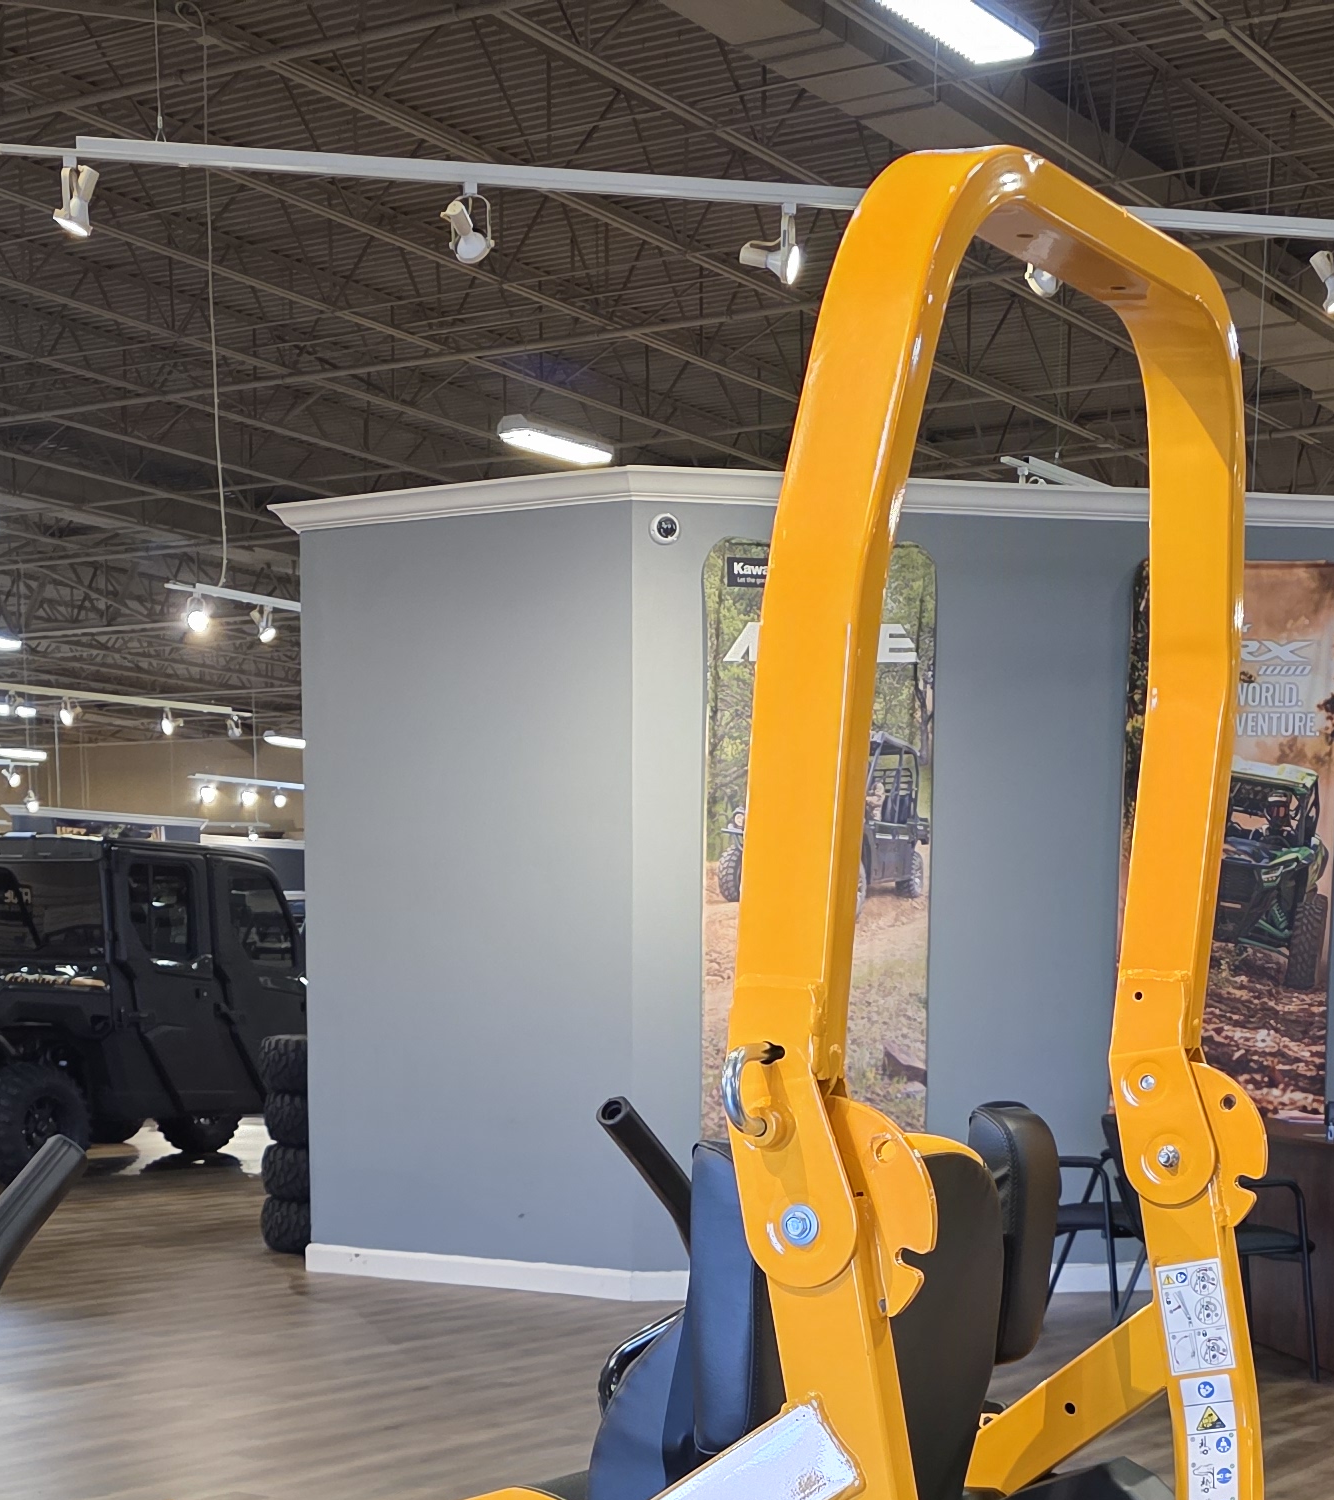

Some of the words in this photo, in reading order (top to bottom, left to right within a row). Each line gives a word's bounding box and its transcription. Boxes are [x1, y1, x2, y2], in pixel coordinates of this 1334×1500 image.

[733, 561, 769, 575] Kawa
[1241, 640, 1313, 661] RX
[1259, 665, 1312, 675] 1000
[1236, 712, 1320, 737] VENTURE.
